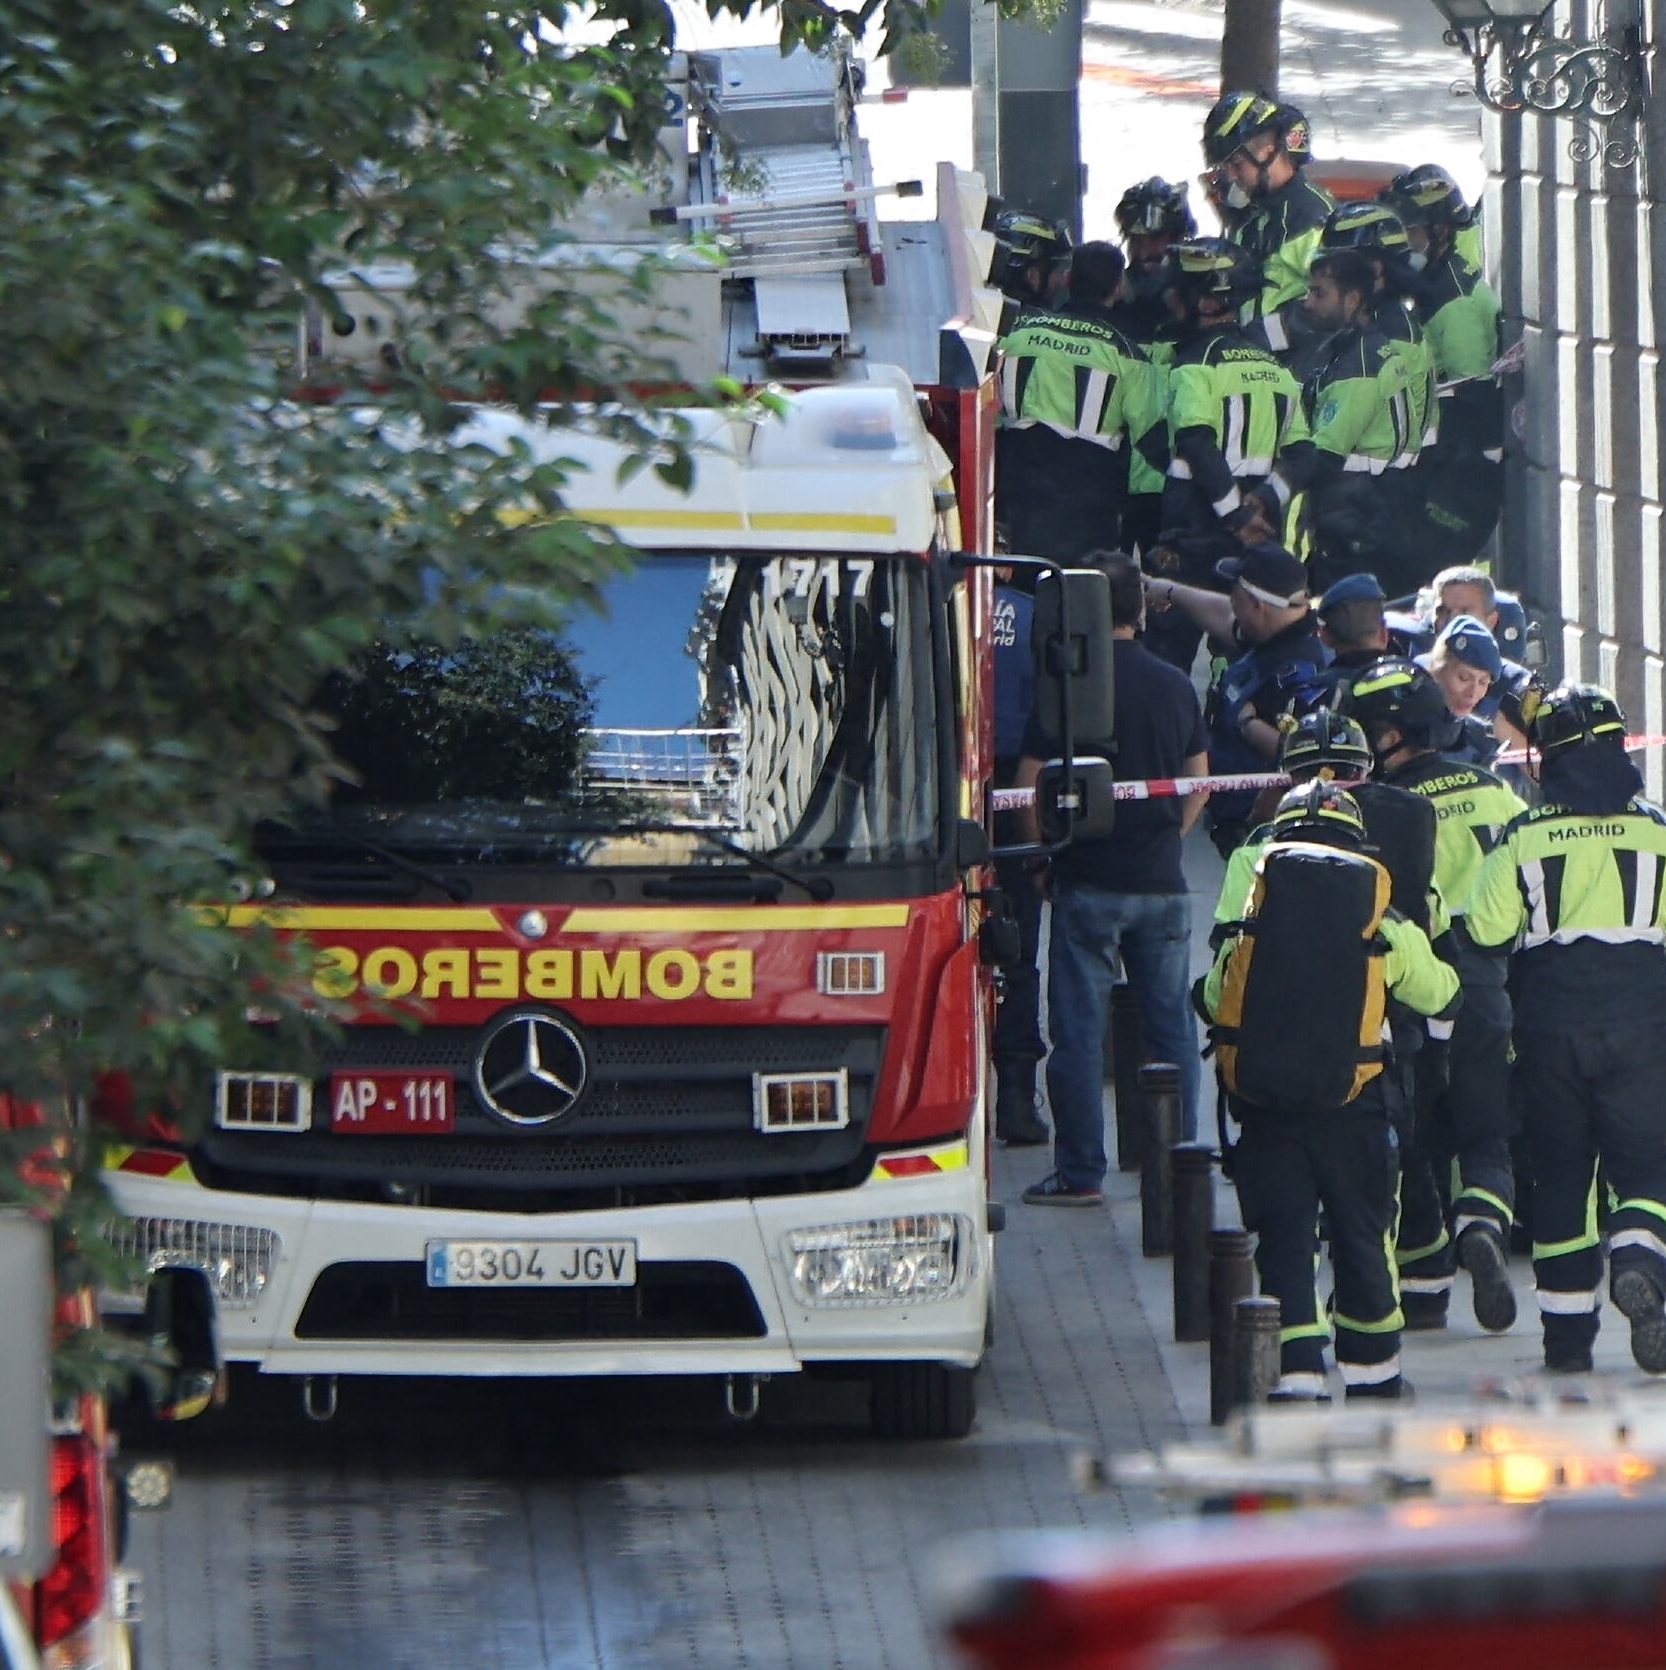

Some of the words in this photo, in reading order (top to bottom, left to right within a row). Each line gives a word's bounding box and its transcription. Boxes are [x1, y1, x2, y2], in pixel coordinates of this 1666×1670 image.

[1027, 334, 1091, 356] MADRID
[1549, 823, 1625, 842] MADRID
[560, 1248, 626, 1280] JGV
